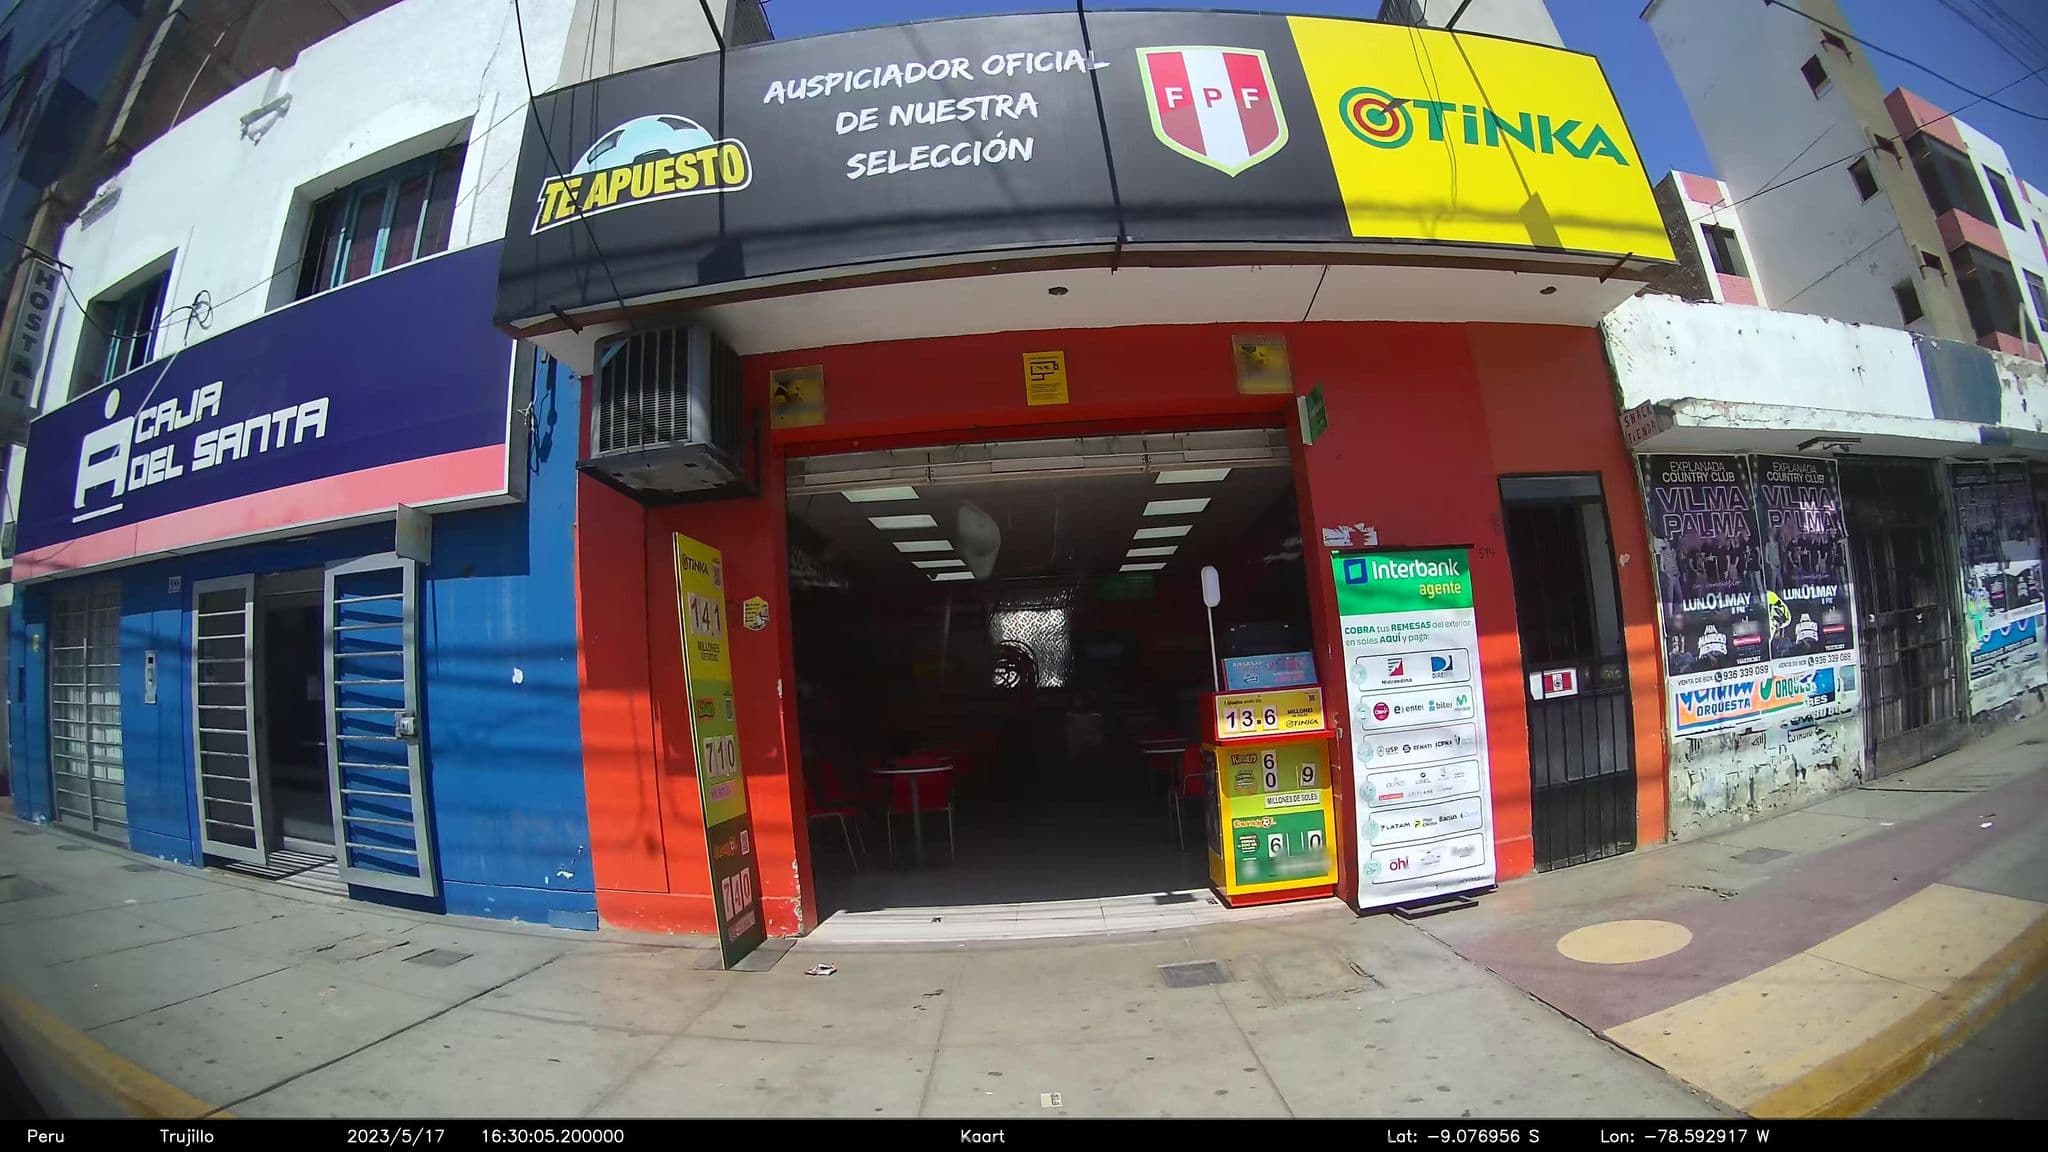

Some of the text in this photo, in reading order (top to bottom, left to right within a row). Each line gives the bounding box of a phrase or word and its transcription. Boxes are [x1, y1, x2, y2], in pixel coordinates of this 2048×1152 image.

[763, 48, 1110, 106] AUSPICIADOR OFICIAL
[836, 91, 1039, 136] DE NUESTRA
[846, 130, 1035, 181] SELECCIÓN
[539, 143, 746, 226] TE APUESTO
[11, 268, 56, 400] HOSTAL
[135, 380, 223, 442] CAJA
[127, 397, 330, 492] DEL SANTA
[1662, 471, 1735, 483] COUNTRY CLUB
[1670, 461, 1726, 472] EXPLANADA
[1772, 461, 1817, 474] EXPLANADA
[1766, 471, 1825, 484] COUNTRY CLUB
[1656, 486, 1749, 513] VILMA
[1762, 485, 1835, 512] VILMA
[1663, 511, 1751, 540] PALMA
[1768, 510, 1835, 534] PALMA
[1371, 558, 1460, 580] Interbank
[1419, 582, 1462, 598] agente
[1344, 625, 1376, 635] COBRA
[1377, 625, 1391, 633] tus
[1391, 621, 1431, 631] REMESAS
[1444, 619, 1471, 628] exterior
[1345, 639, 1356, 647] en
[1357, 637, 1379, 646] soles
[1402, 636, 1407, 644] y
[1696, 697, 1751, 717] ORQUESTA
[1225, 708, 1276, 729] 13.6
[704, 735, 735, 774] 710
[1264, 754, 1275, 769] 6
[1266, 772, 1276, 788] 0
[1303, 766, 1314, 782] 9
[1267, 793, 1318, 805] MILLONES DE SOLES
[1386, 822, 1410, 830] LATAM
[1270, 837, 1281, 854] 6
[723, 873, 751, 917] 740
